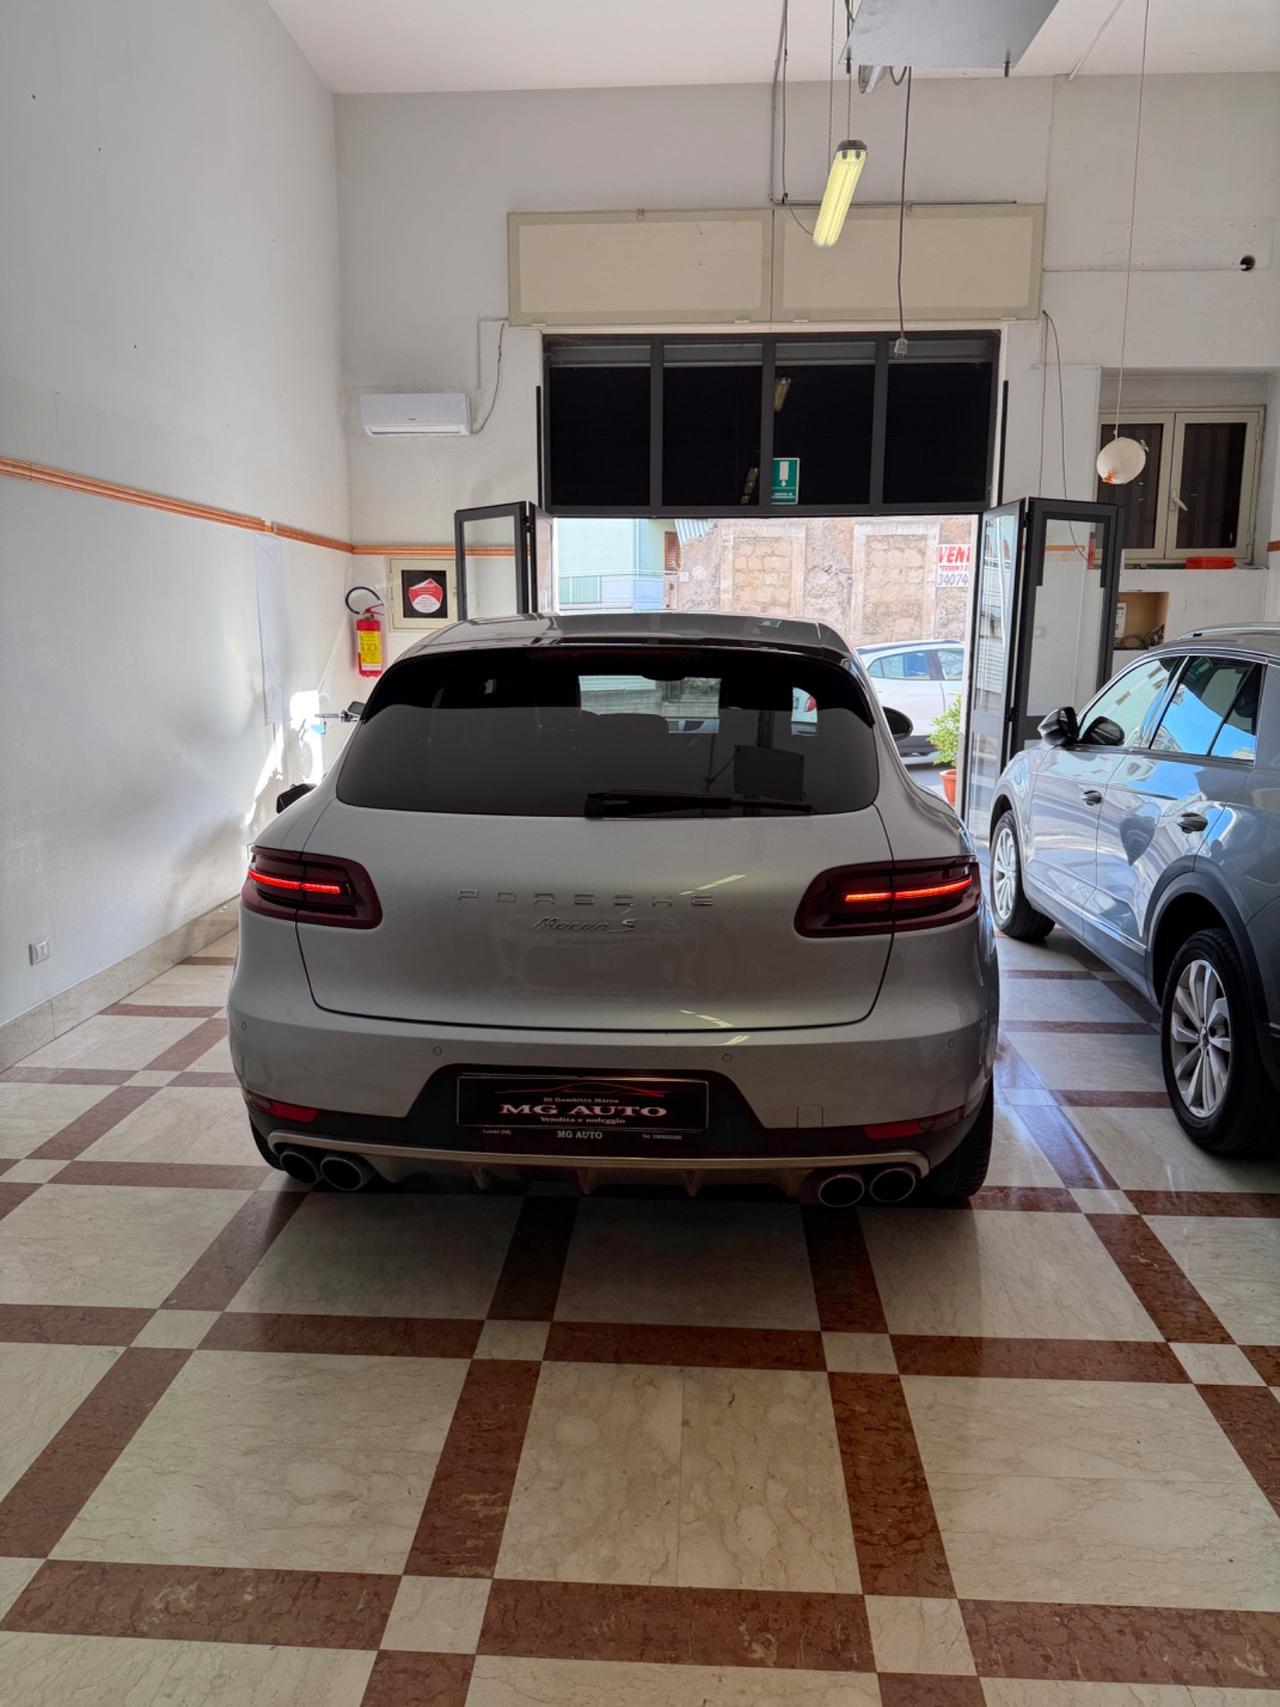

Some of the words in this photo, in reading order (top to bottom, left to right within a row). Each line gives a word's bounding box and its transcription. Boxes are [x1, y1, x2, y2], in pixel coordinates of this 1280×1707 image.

[457, 889, 713, 907] PORSCHE
[499, 1104, 558, 1115] MG
[569, 1104, 668, 1117] AUTO
[556, 1130, 573, 1139] MG
[575, 1130, 604, 1140] AUTO
